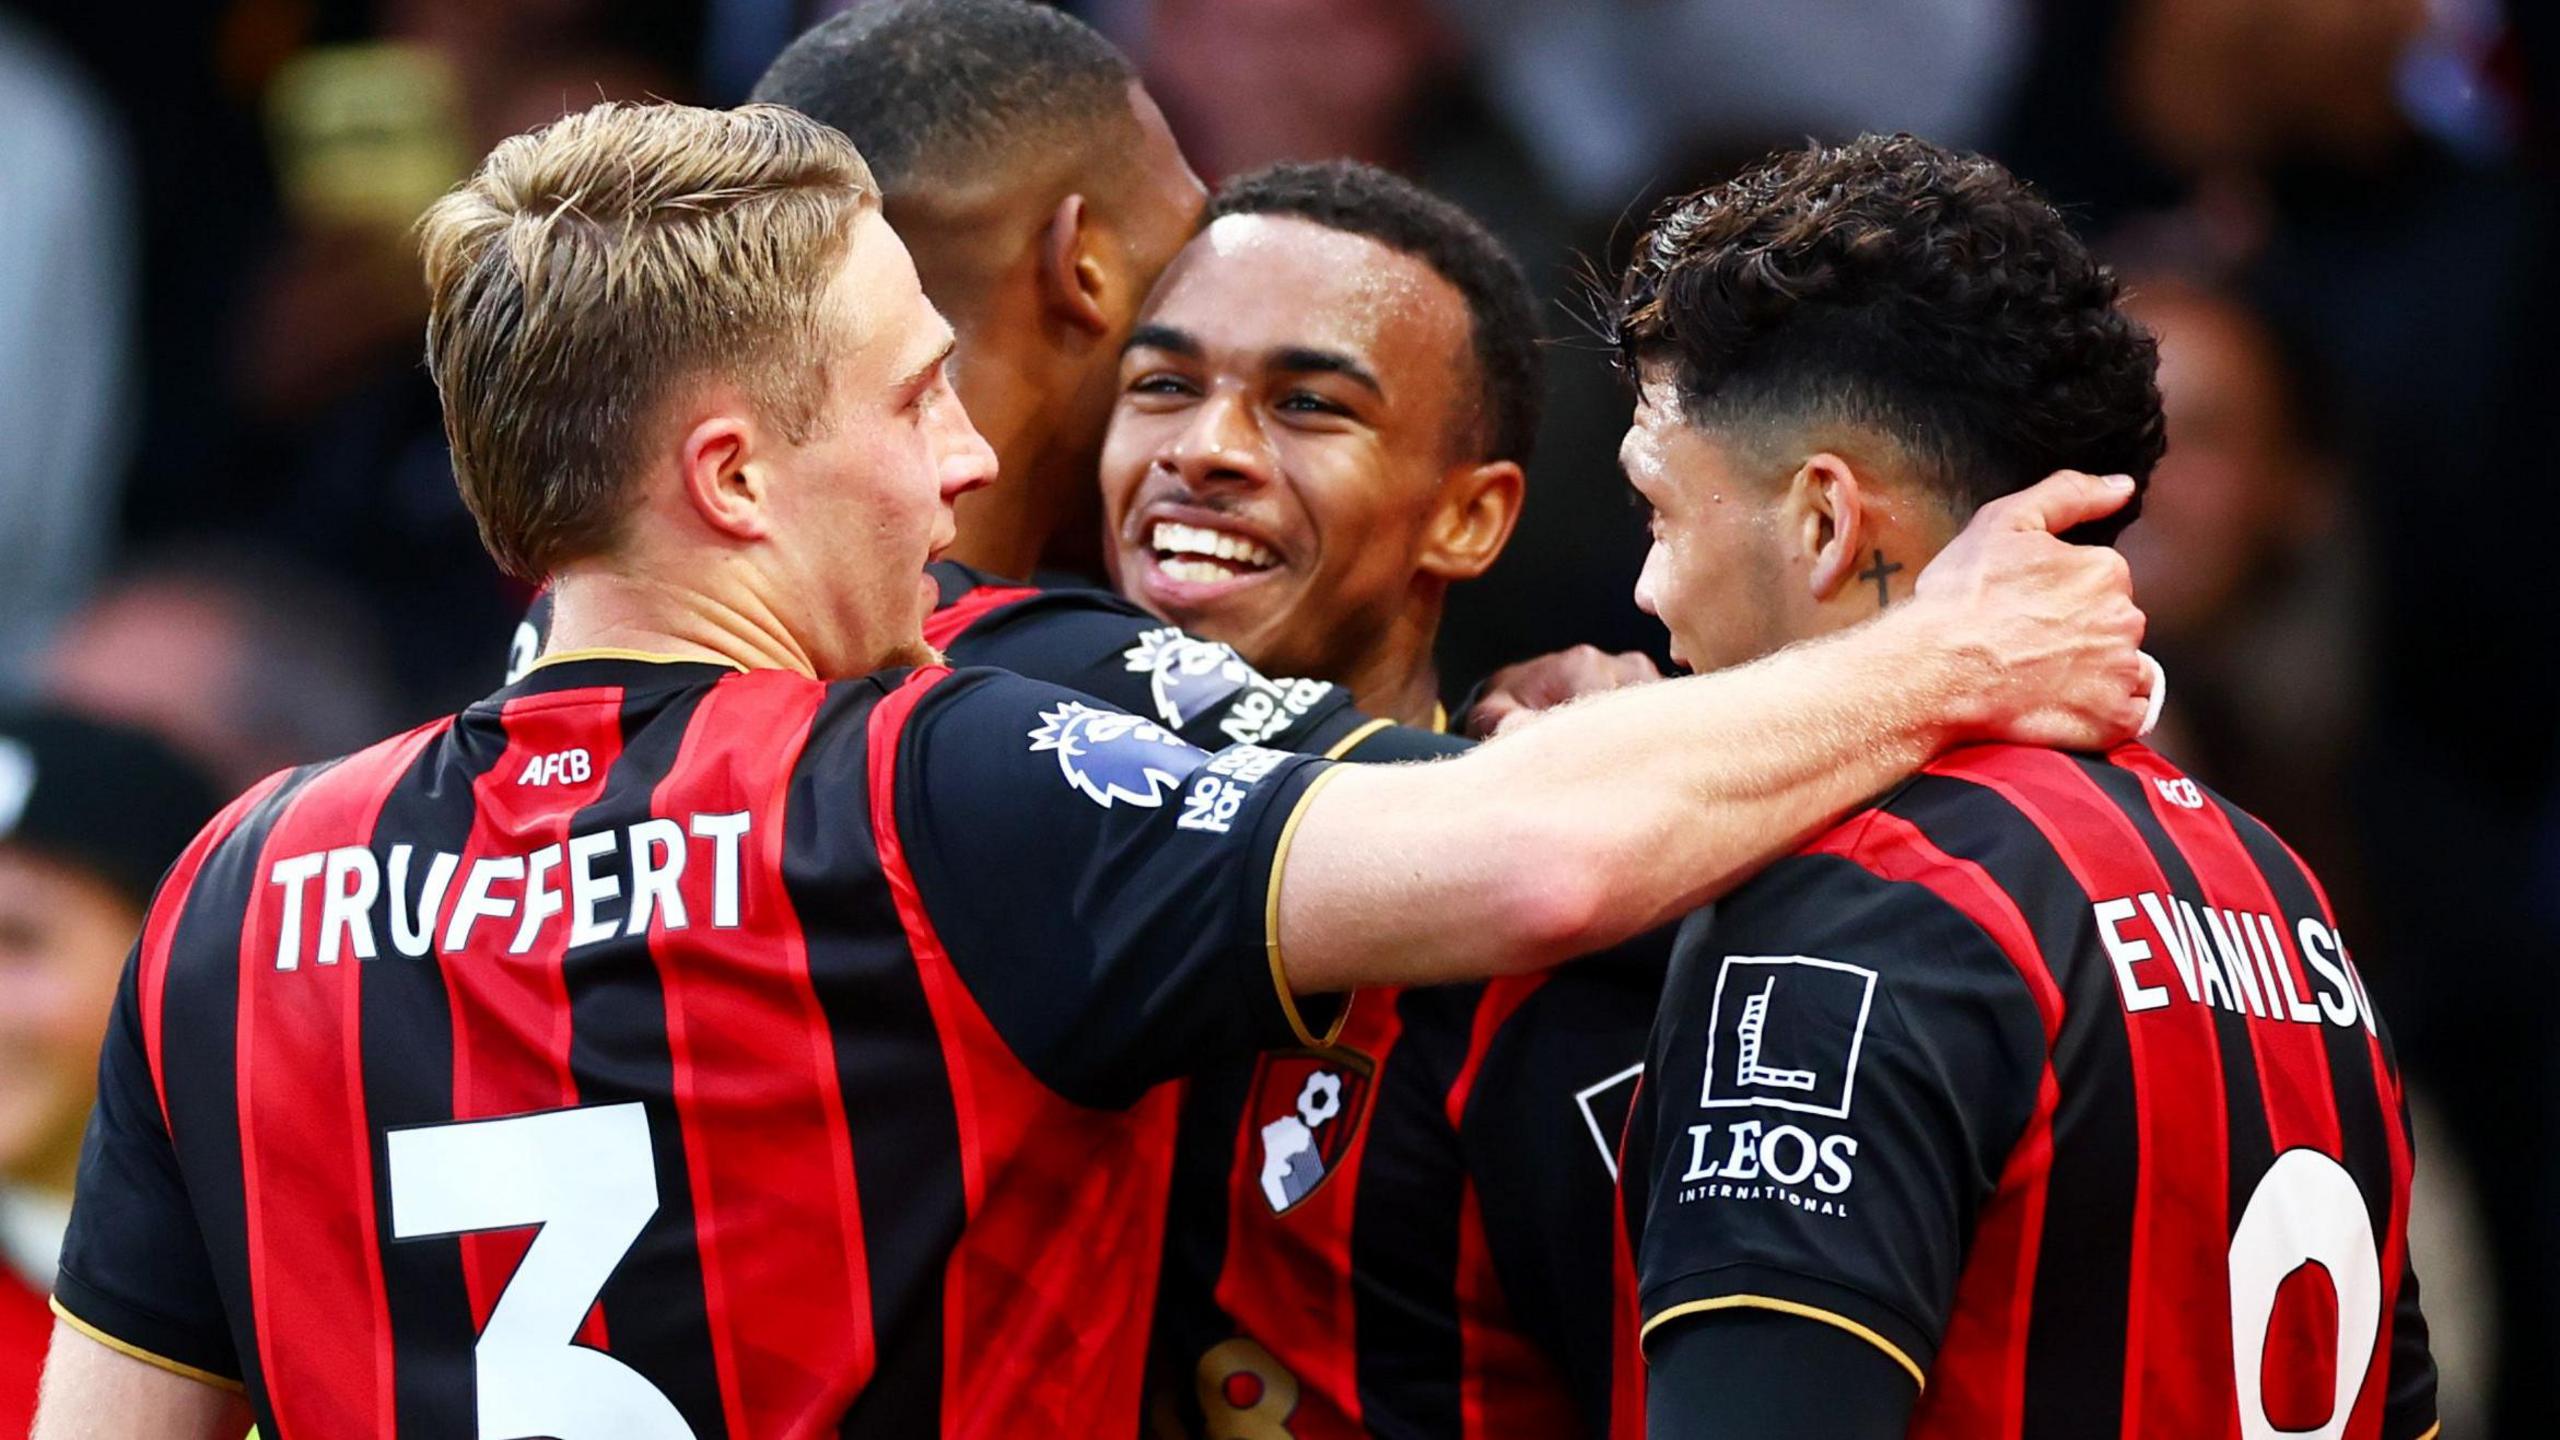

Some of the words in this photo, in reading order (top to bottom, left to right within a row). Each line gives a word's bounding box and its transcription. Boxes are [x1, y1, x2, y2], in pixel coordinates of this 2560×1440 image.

[517, 748, 592, 786] AFCB
[271, 811, 750, 971] TRUFFERT
[1681, 1120, 1858, 1194] LEOS
[1678, 1183, 1848, 1218] INTERNATIONAL
